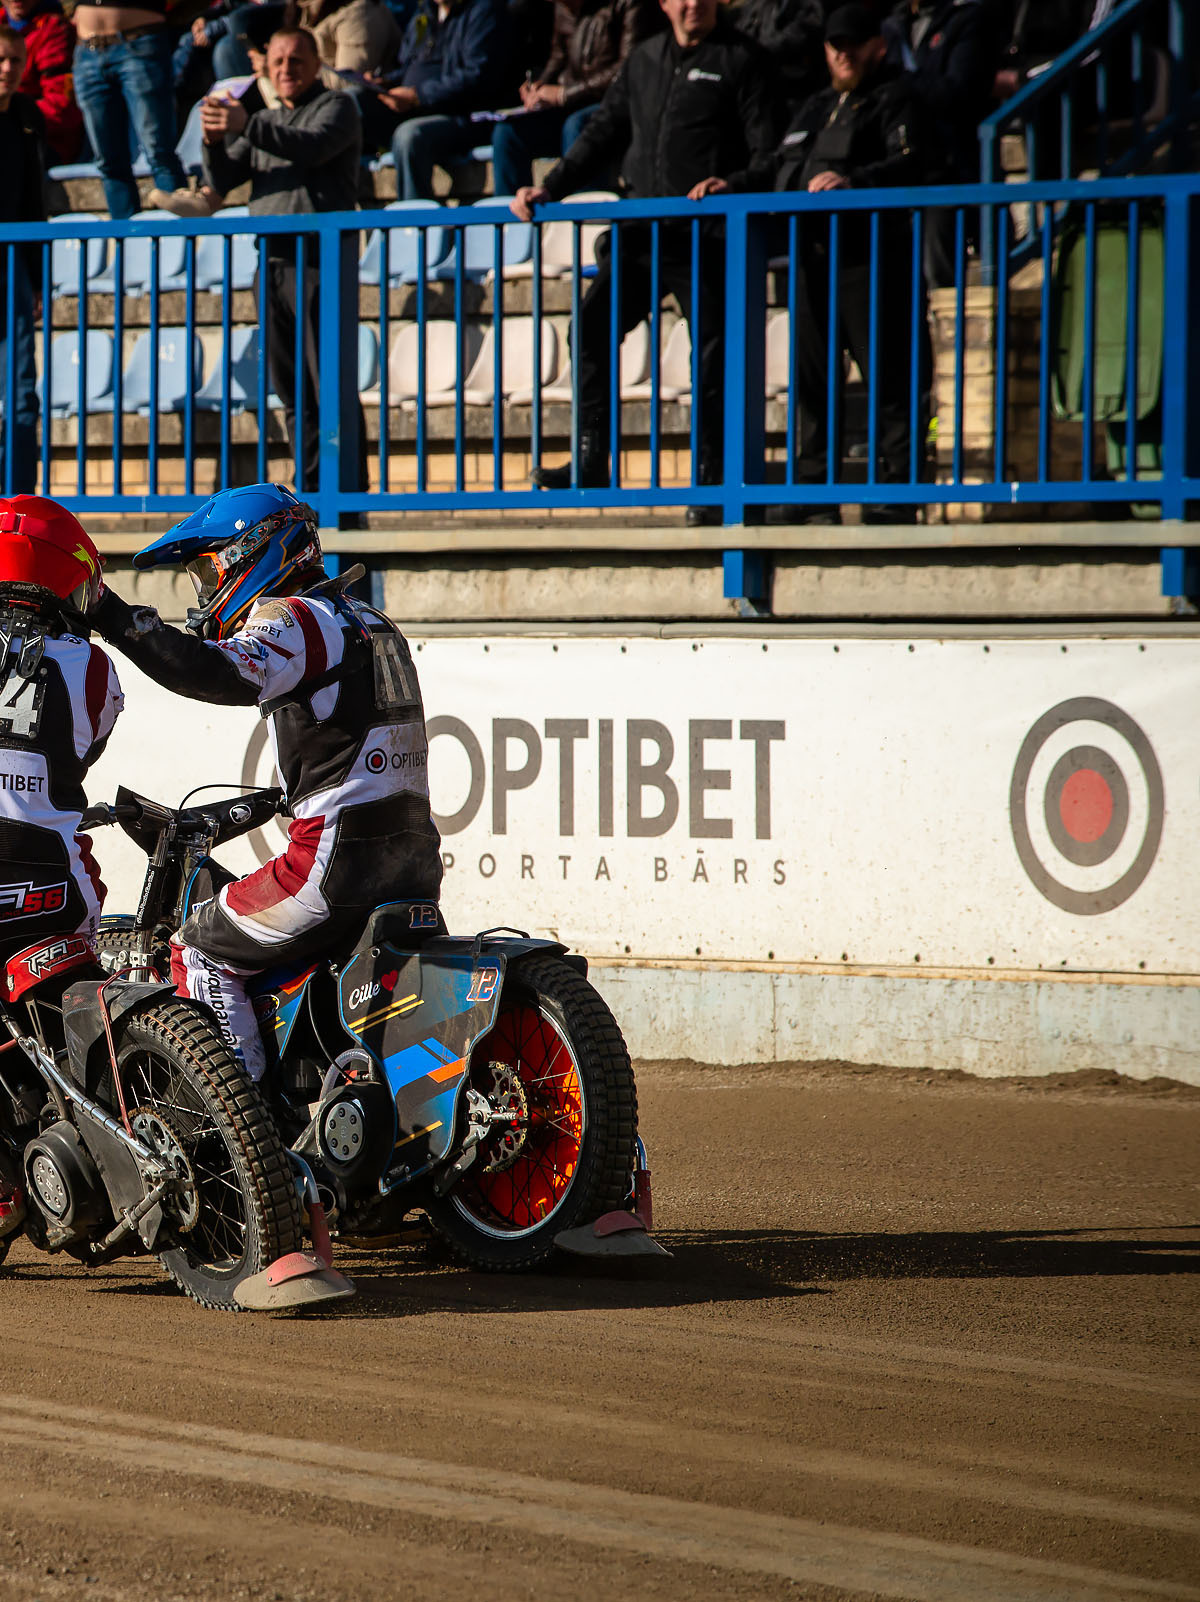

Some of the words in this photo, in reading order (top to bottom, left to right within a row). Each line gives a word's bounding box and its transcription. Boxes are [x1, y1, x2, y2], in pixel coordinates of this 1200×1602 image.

[252, 624, 283, 639] TIBET
[426, 714, 786, 840] OPTIBET
[442, 852, 611, 881] PORTA
[654, 849, 787, 885] BĀRS
[409, 904, 439, 929] 12
[349, 980, 381, 1010] Cille
[466, 966, 499, 1002] 12
